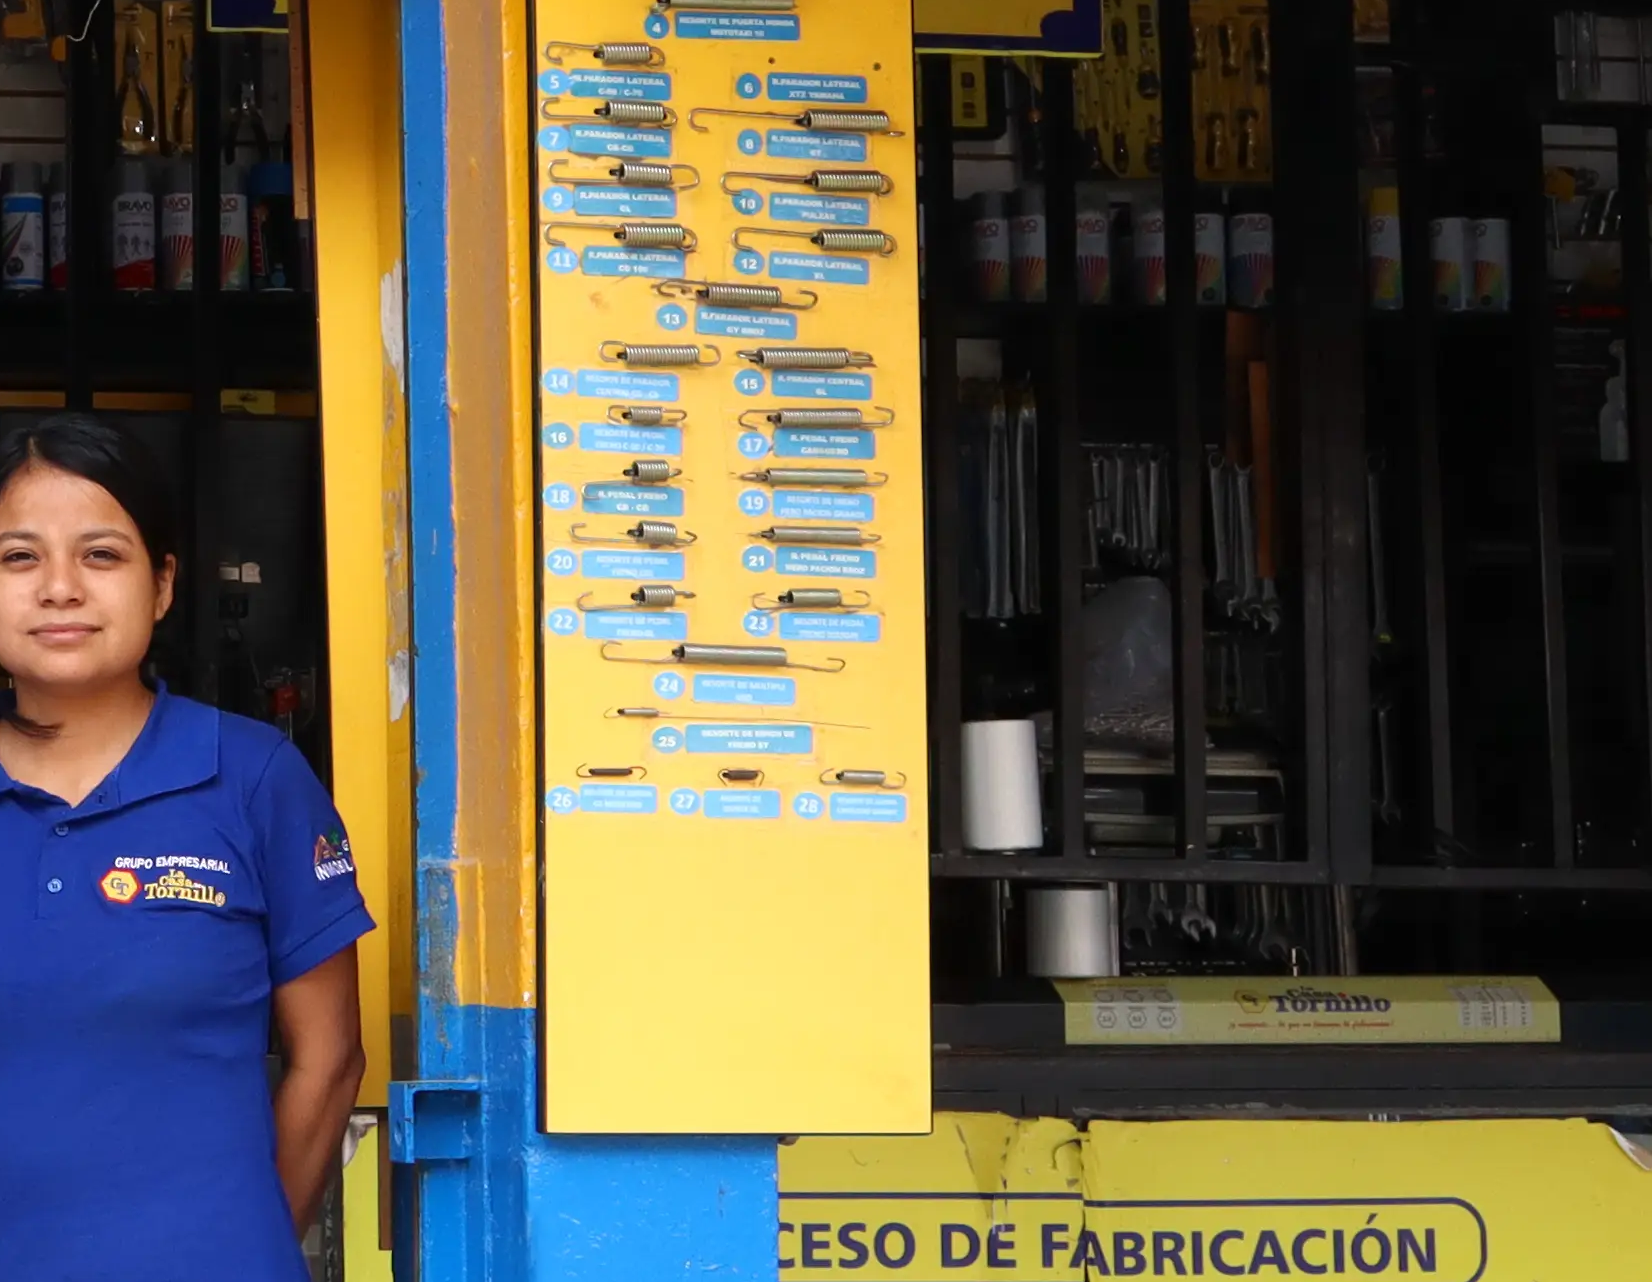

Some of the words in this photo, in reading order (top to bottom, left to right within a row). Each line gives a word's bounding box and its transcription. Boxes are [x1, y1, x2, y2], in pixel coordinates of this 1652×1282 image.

[651, 22, 662, 34] 4
[550, 75, 560, 89] 5
[744, 82, 754, 94] 6
[549, 132, 559, 146] 7
[745, 138, 754, 150] 8
[117, 199, 154, 213] BRAVO
[552, 192, 563, 206] 9
[552, 252, 572, 267] 11
[740, 259, 758, 270] 12
[663, 314, 681, 326] 13
[550, 375, 569, 389] 14
[740, 378, 759, 390] 15
[549, 432, 568, 444] 16
[744, 438, 763, 453] 17
[551, 489, 570, 504] 18
[744, 496, 764, 510] 19
[553, 554, 573, 569] 20
[748, 555, 765, 567] 21
[553, 614, 574, 630] 22
[749, 616, 768, 631] 23
[659, 677, 679, 693] 24
[658, 735, 677, 748] 25
[552, 793, 573, 809] 26
[675, 793, 695, 809] 27
[798, 797, 818, 814] 28
[114, 856, 153, 870] GRUPO
[155, 855, 231, 874] EMPRESARIAL
[110, 877, 130, 897] GT
[1268, 993, 1392, 1014] Tornillo
[940, 1222, 1018, 1269] DE
[1041, 1212, 1437, 1276] FABRICACIÓN
